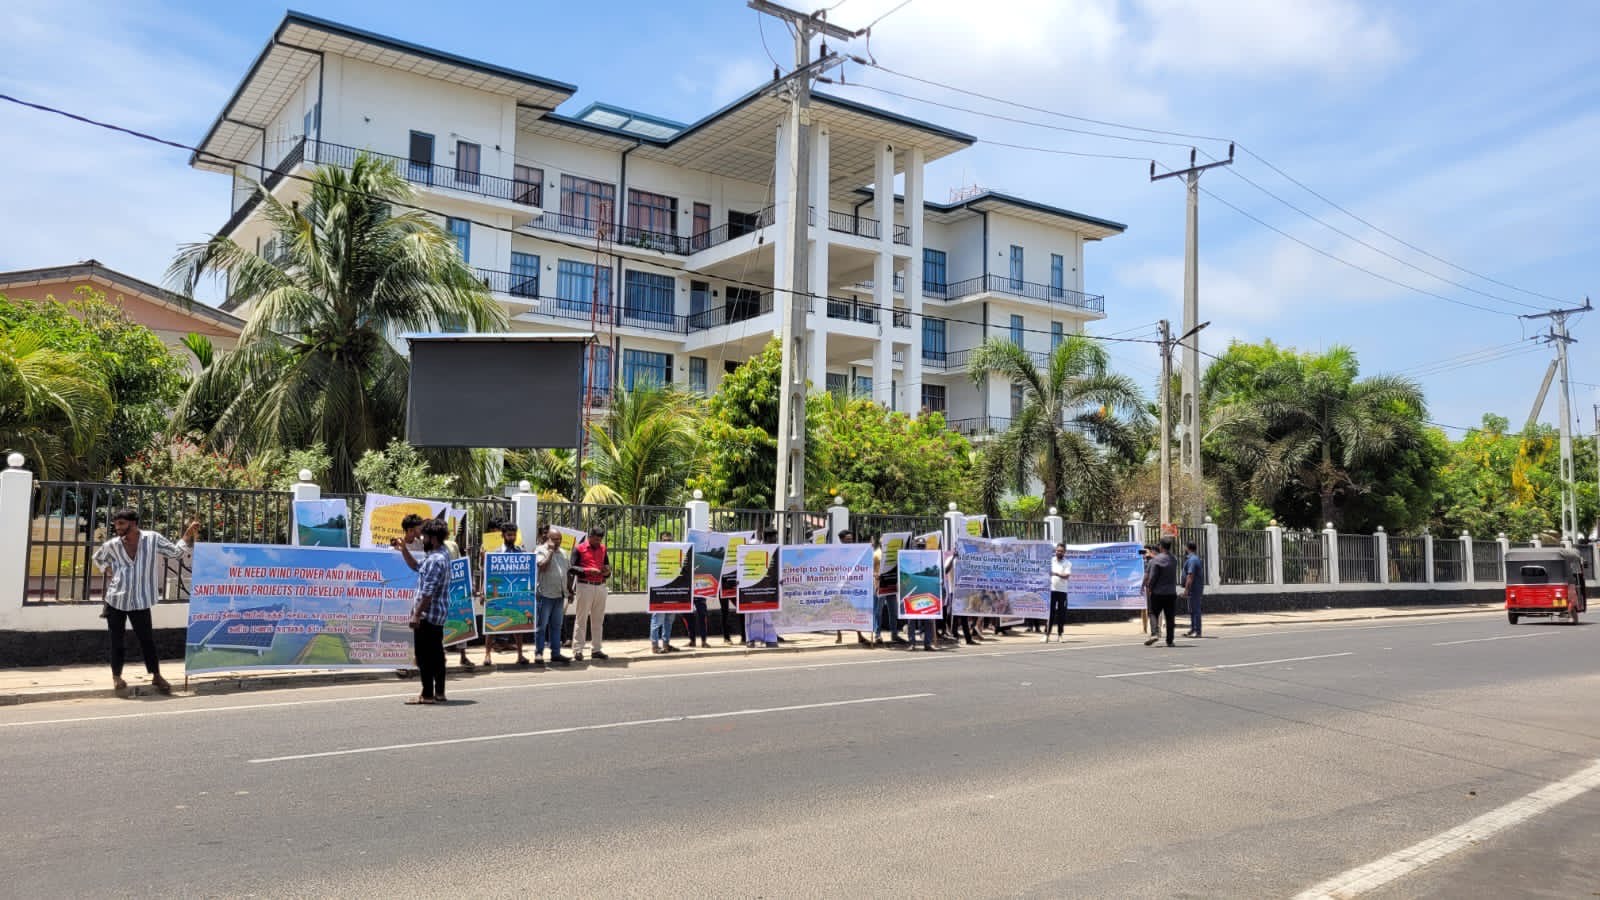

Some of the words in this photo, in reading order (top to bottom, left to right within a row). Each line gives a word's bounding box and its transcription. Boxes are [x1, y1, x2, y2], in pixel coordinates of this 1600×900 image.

[491, 555, 531, 563] DEVELOP
[1002, 556, 1020, 564] Wind
[491, 563, 530, 571] MANNAR
[809, 565, 818, 573] to
[820, 565, 852, 573] Develop
[854, 564, 870, 572] Our
[993, 564, 1018, 572] Mannar
[229, 567, 243, 578] WE
[244, 567, 267, 578] NEED
[269, 567, 292, 579] WIND
[294, 568, 324, 580] POWER
[325, 569, 344, 580] AND
[345, 569, 383, 582] MINERAL
[807, 574, 837, 582] Mannar
[193, 584, 215, 596] SAND
[216, 584, 250, 596] MINING
[251, 584, 293, 596] PROJECTS
[295, 585, 305, 596] TO
[307, 585, 345, 597] DEVELOP
[346, 586, 383, 598] MANNAR
[384, 588, 415, 600] ISLAND
[383, 650, 407, 658] MANNAR
